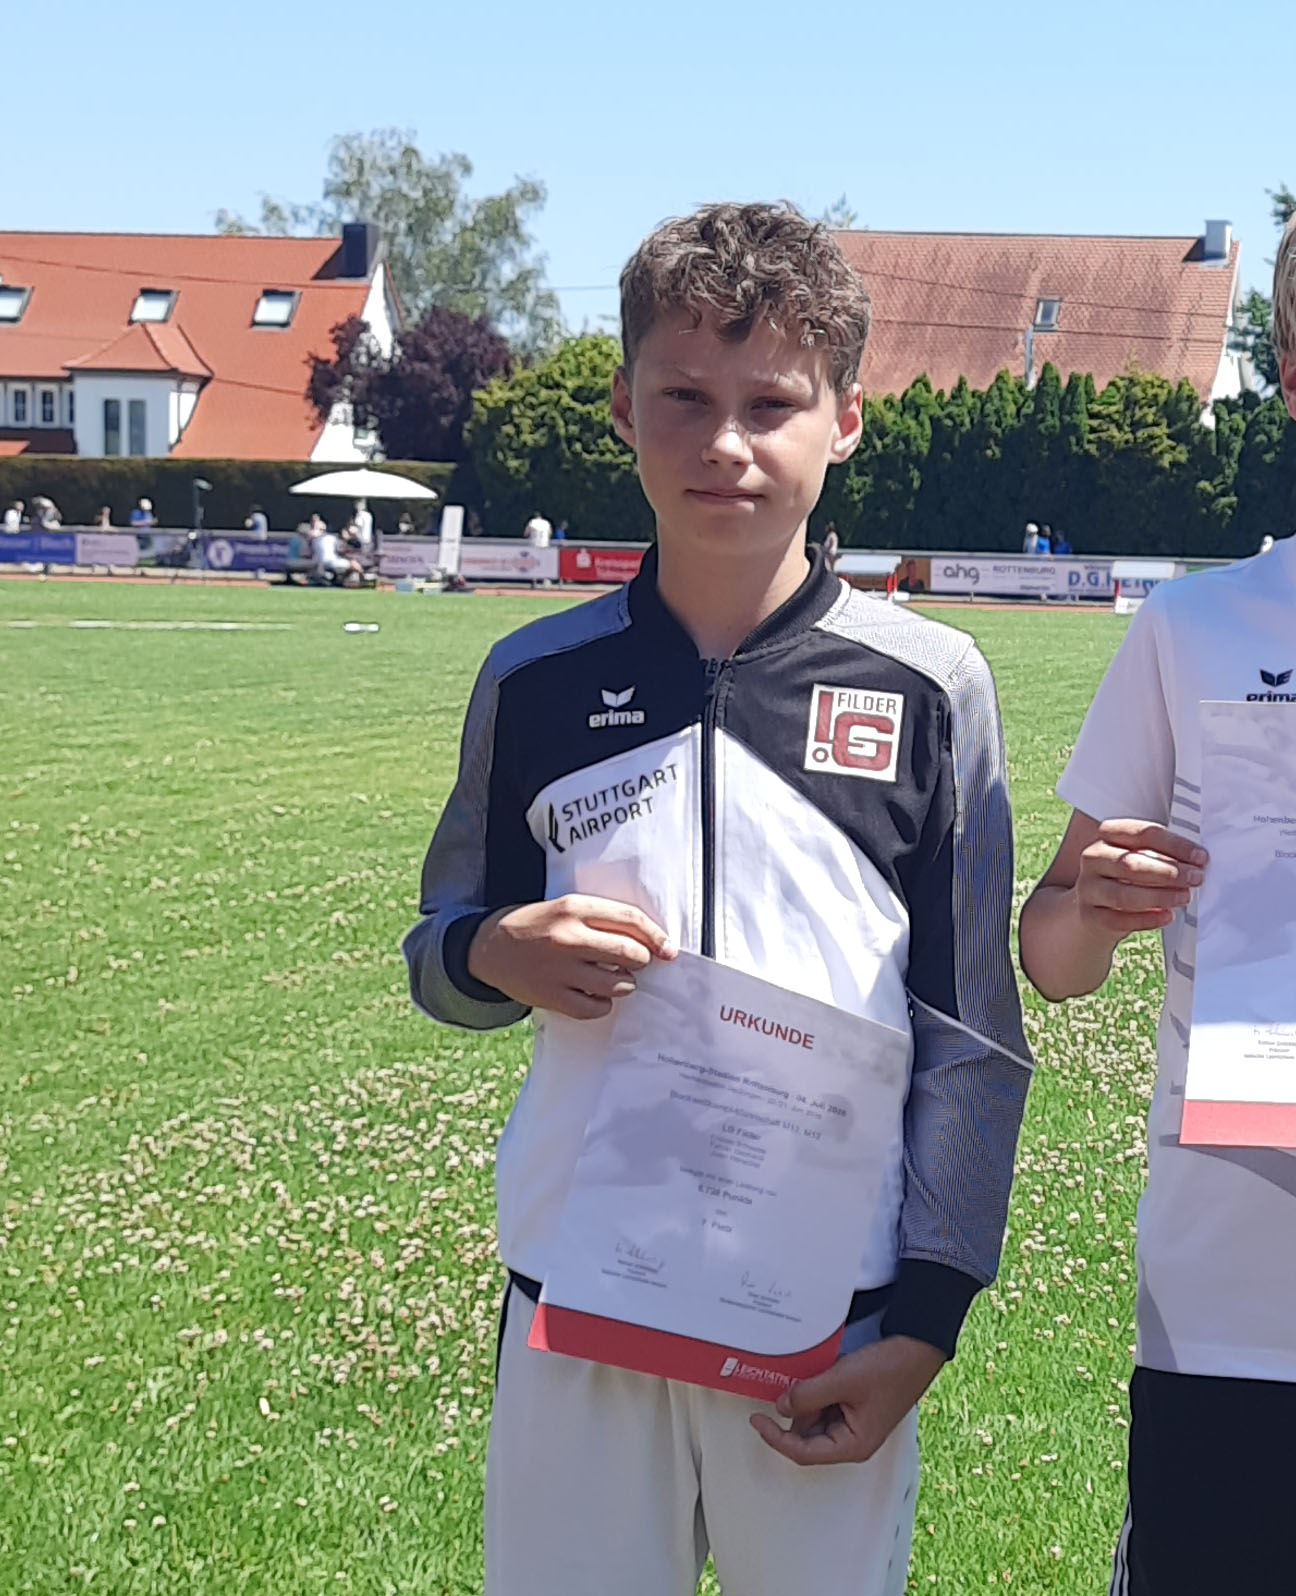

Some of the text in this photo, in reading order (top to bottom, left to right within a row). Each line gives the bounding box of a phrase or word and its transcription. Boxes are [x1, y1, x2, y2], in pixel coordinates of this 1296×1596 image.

[943, 563, 980, 585] ahg
[588, 708, 646, 729] erima
[836, 691, 898, 715] FILDER
[561, 762, 680, 822] STUTTGART
[567, 797, 656, 845] AIRPORT
[719, 1004, 817, 1050] URKUNDE
